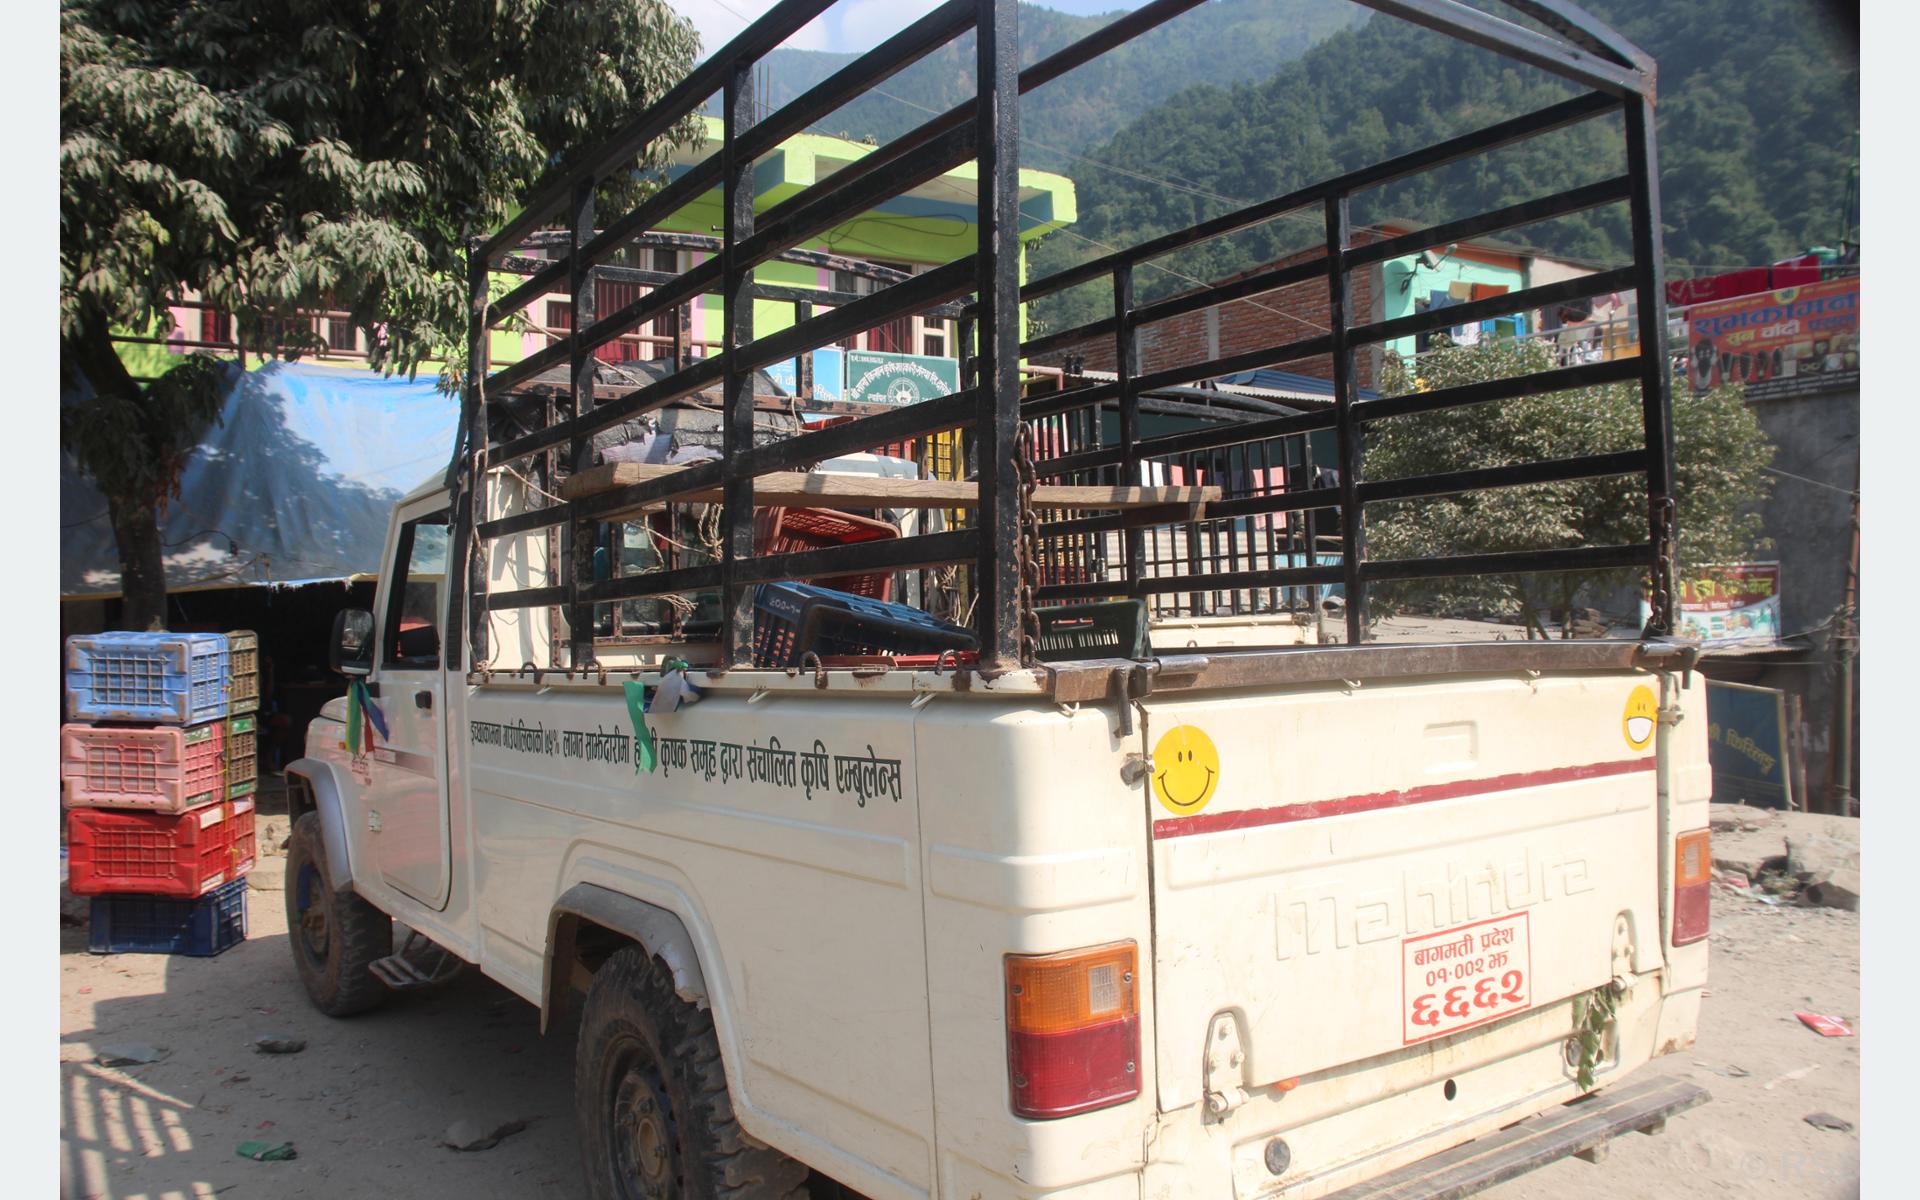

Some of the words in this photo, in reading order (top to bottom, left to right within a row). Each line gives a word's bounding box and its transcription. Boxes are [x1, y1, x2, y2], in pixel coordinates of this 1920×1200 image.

[563, 731, 584, 759] लागत
[585, 725, 630, 764] साझेदारीमा
[661, 737, 687, 778] कृषक
[690, 739, 717, 782] समूह
[720, 742, 743, 784] द्वारा
[747, 736, 796, 788] संचालित
[800, 739, 829, 800] कृषि
[834, 744, 902, 808] एम्बुलेन्स
[1414, 934, 1474, 966] बागमती
[1480, 927, 1515, 952] प्रदेश
[1488, 950, 1509, 969] झ
[1411, 970, 1524, 1026] ६६६२
